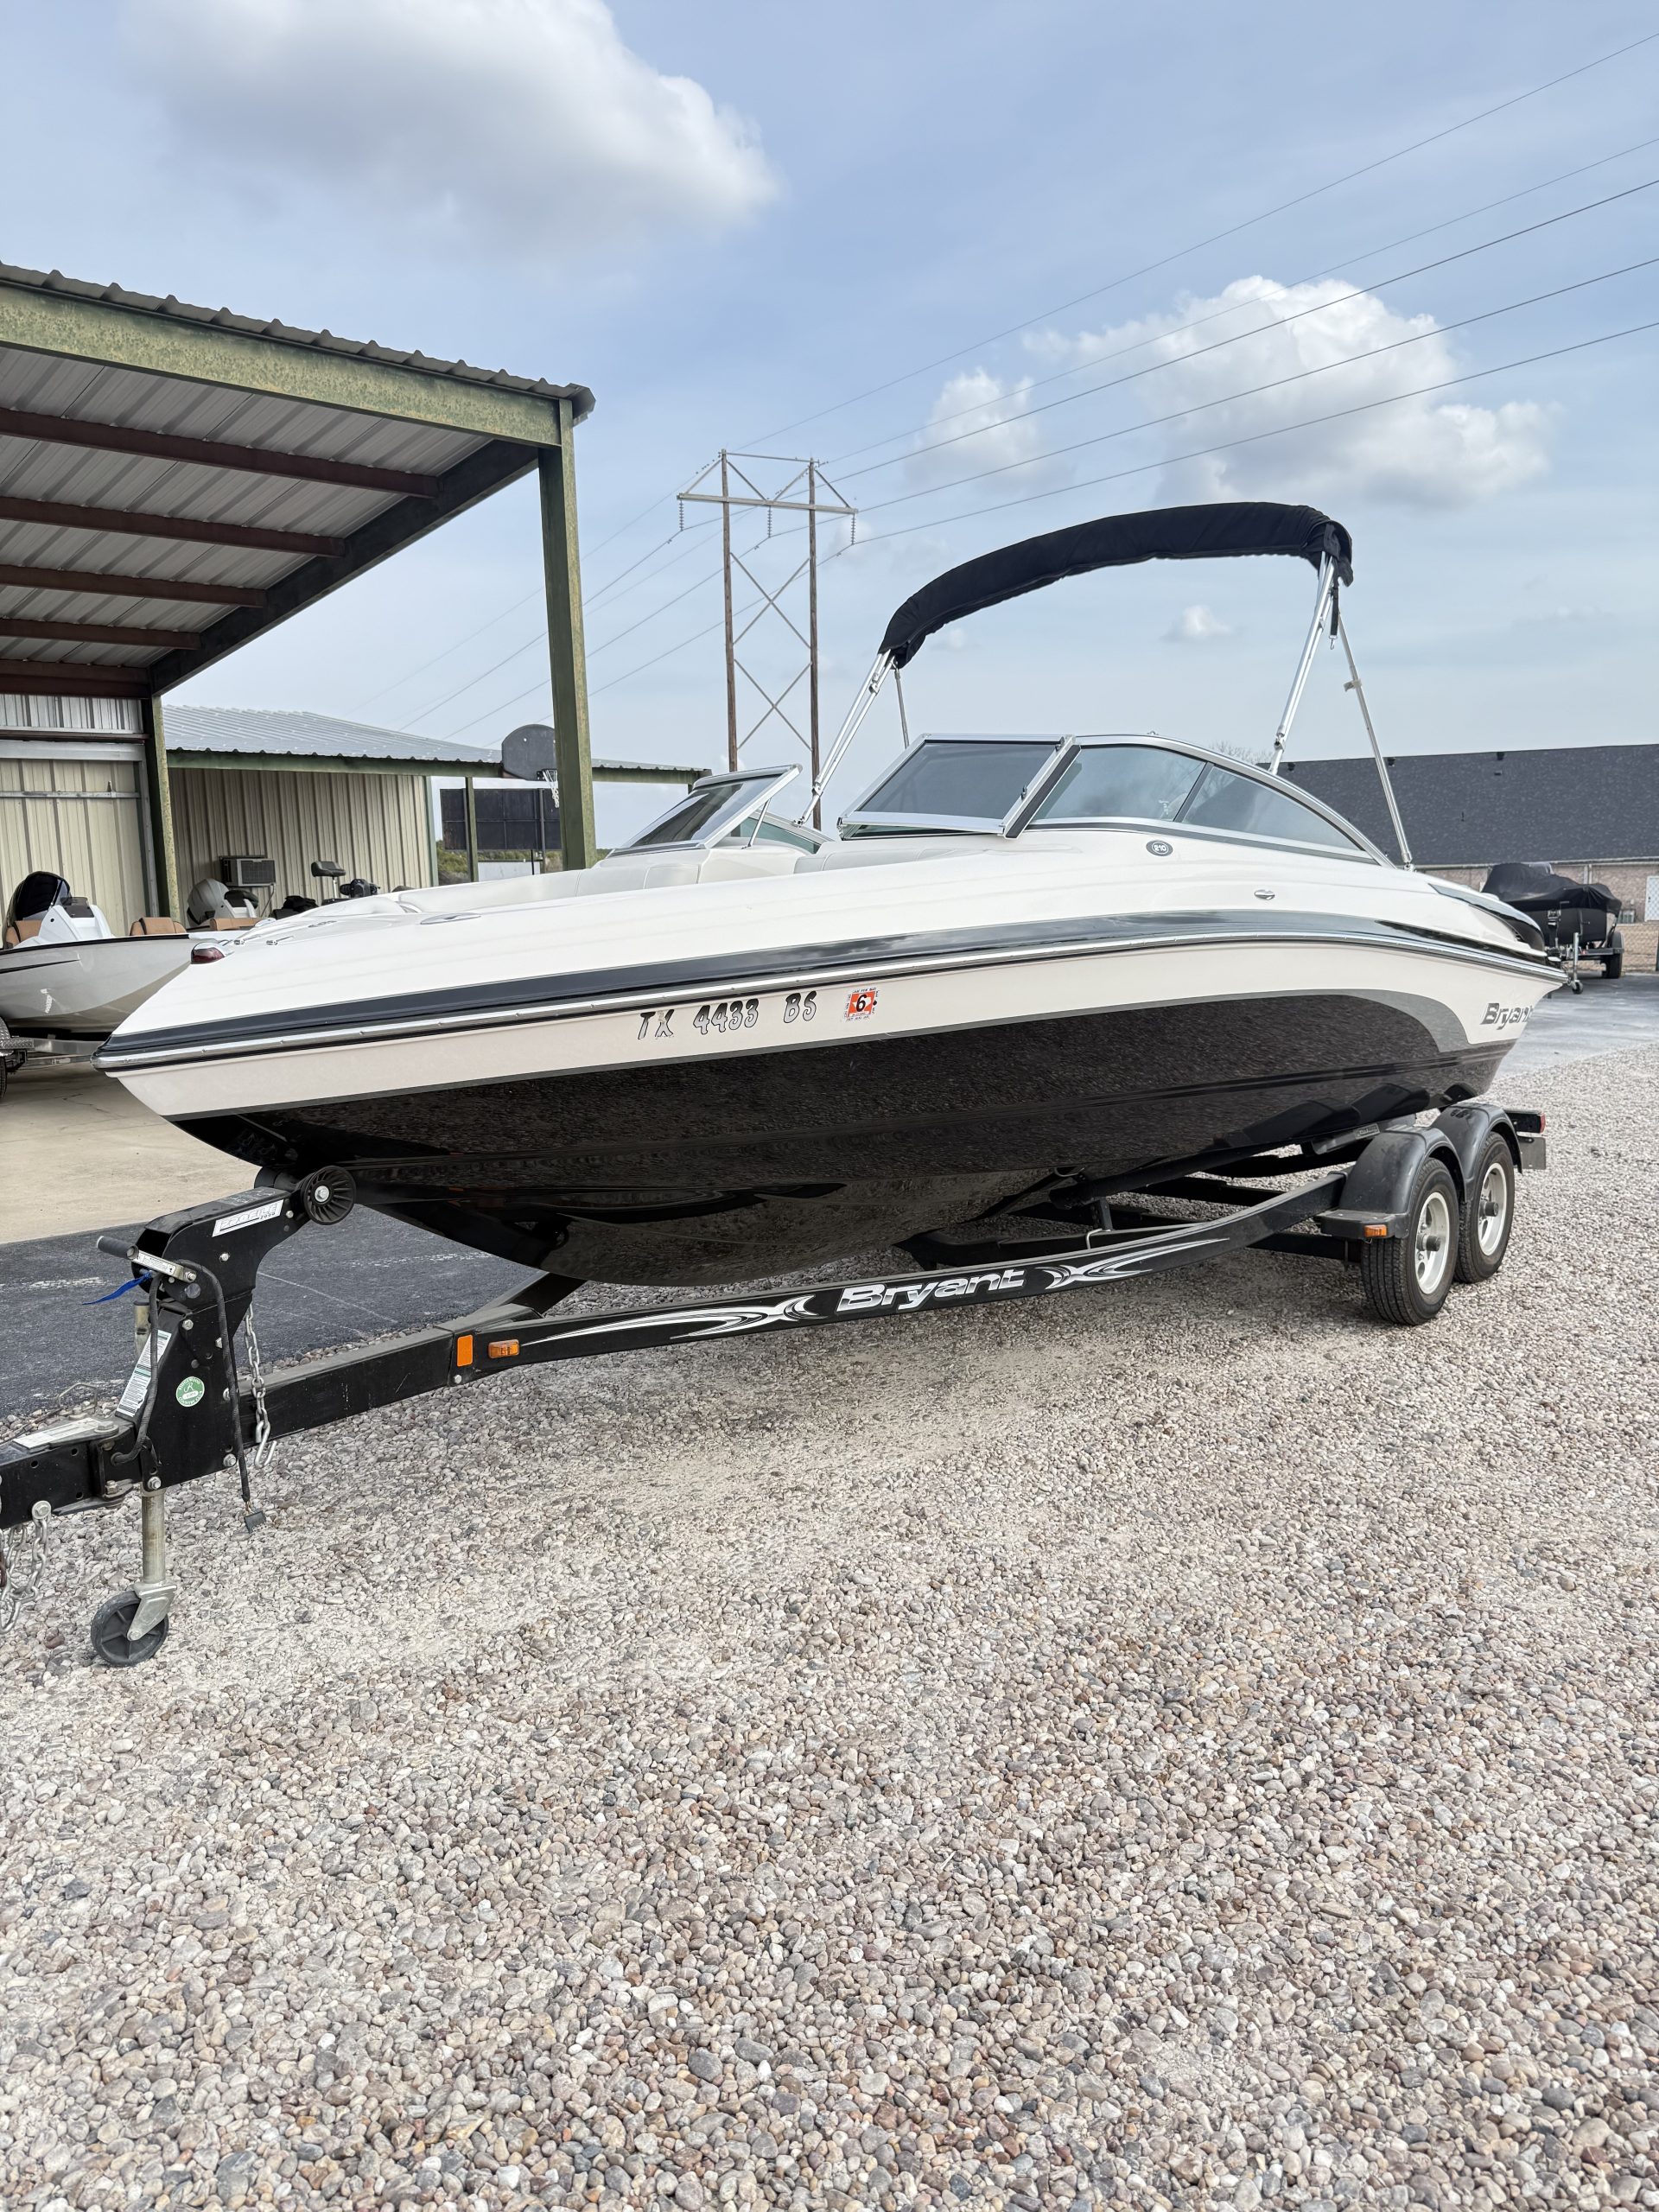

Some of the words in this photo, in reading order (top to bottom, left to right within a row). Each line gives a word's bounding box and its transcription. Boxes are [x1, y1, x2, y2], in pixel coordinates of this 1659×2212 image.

[638, 1008, 675, 1039] TX
[693, 998, 760, 1035] 4433
[783, 991, 817, 1023] BS
[855, 994, 868, 1012] 6
[836, 1269, 1025, 1312] Bryant
